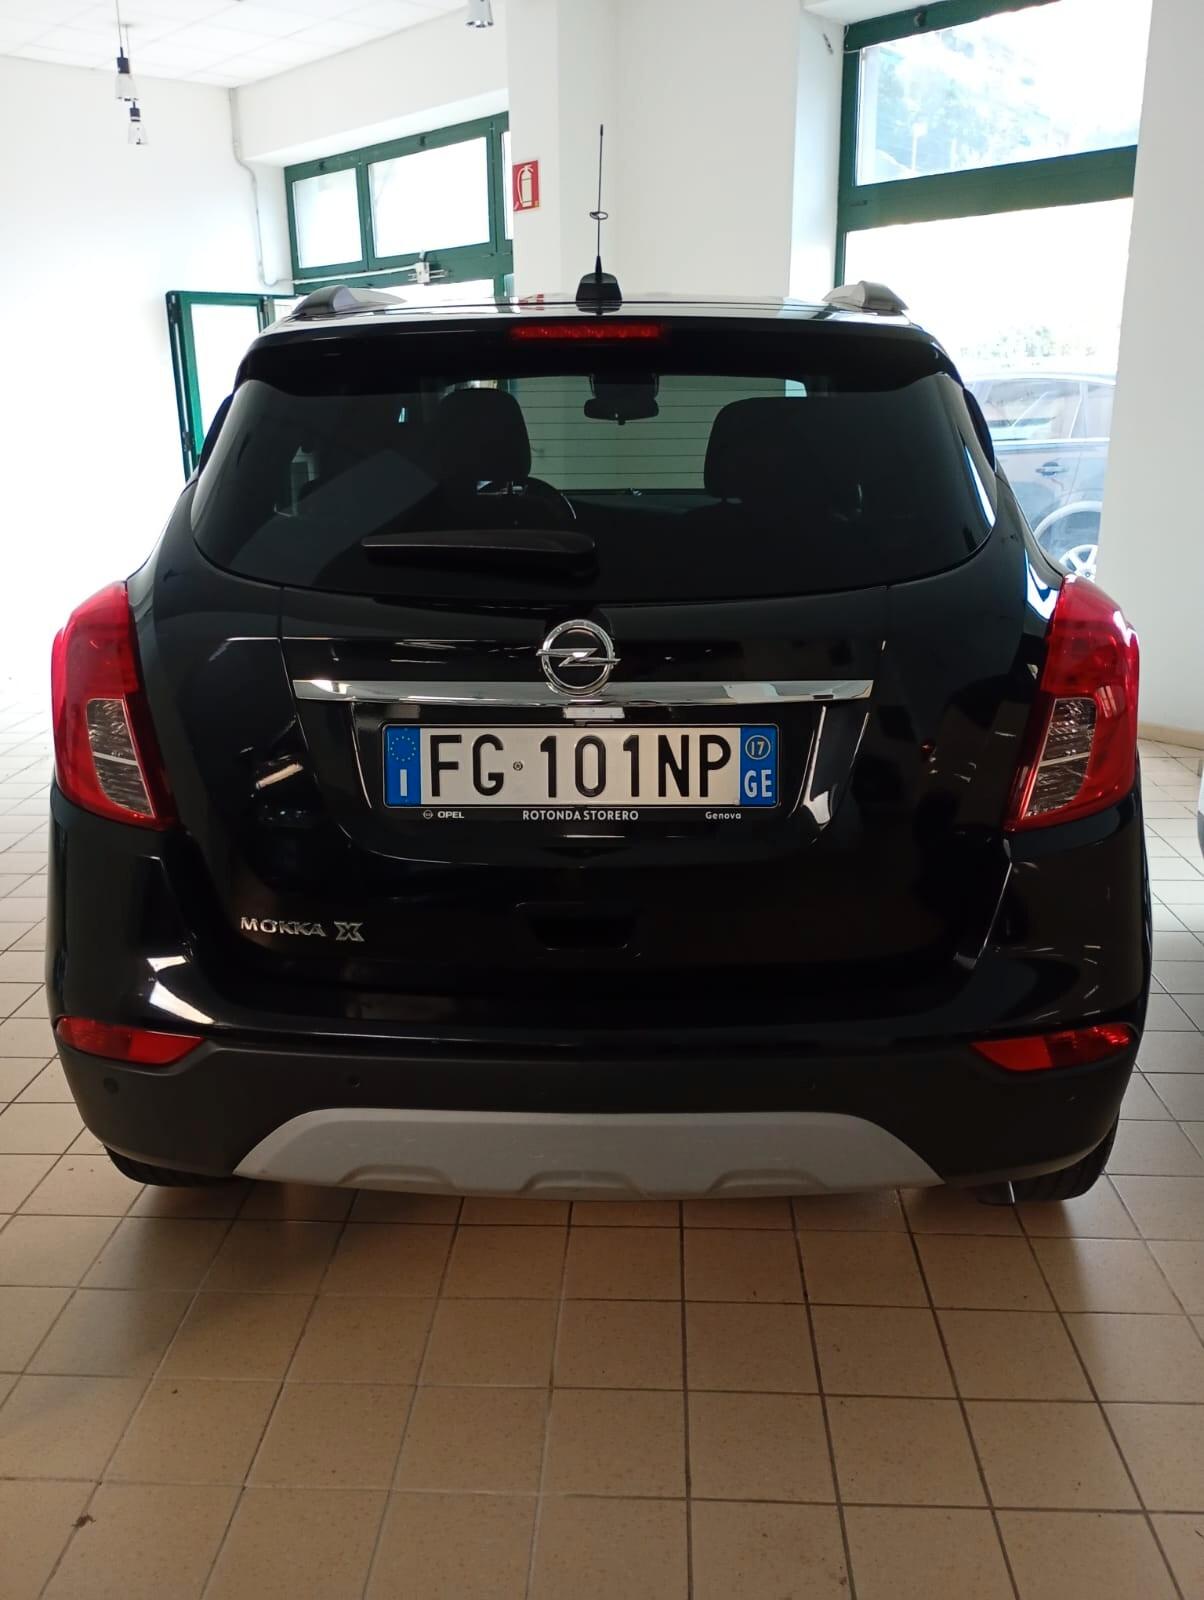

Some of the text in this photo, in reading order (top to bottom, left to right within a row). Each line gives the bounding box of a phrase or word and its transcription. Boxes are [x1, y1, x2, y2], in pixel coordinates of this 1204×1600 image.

[750, 741, 765, 756] 17
[430, 734, 732, 798] FG 101NP
[744, 769, 773, 798] GE
[437, 810, 465, 819] OPEL
[522, 810, 639, 821] ROTONDA STORERO
[705, 811, 742, 820] Genova
[240, 916, 365, 942] MOKKA X
